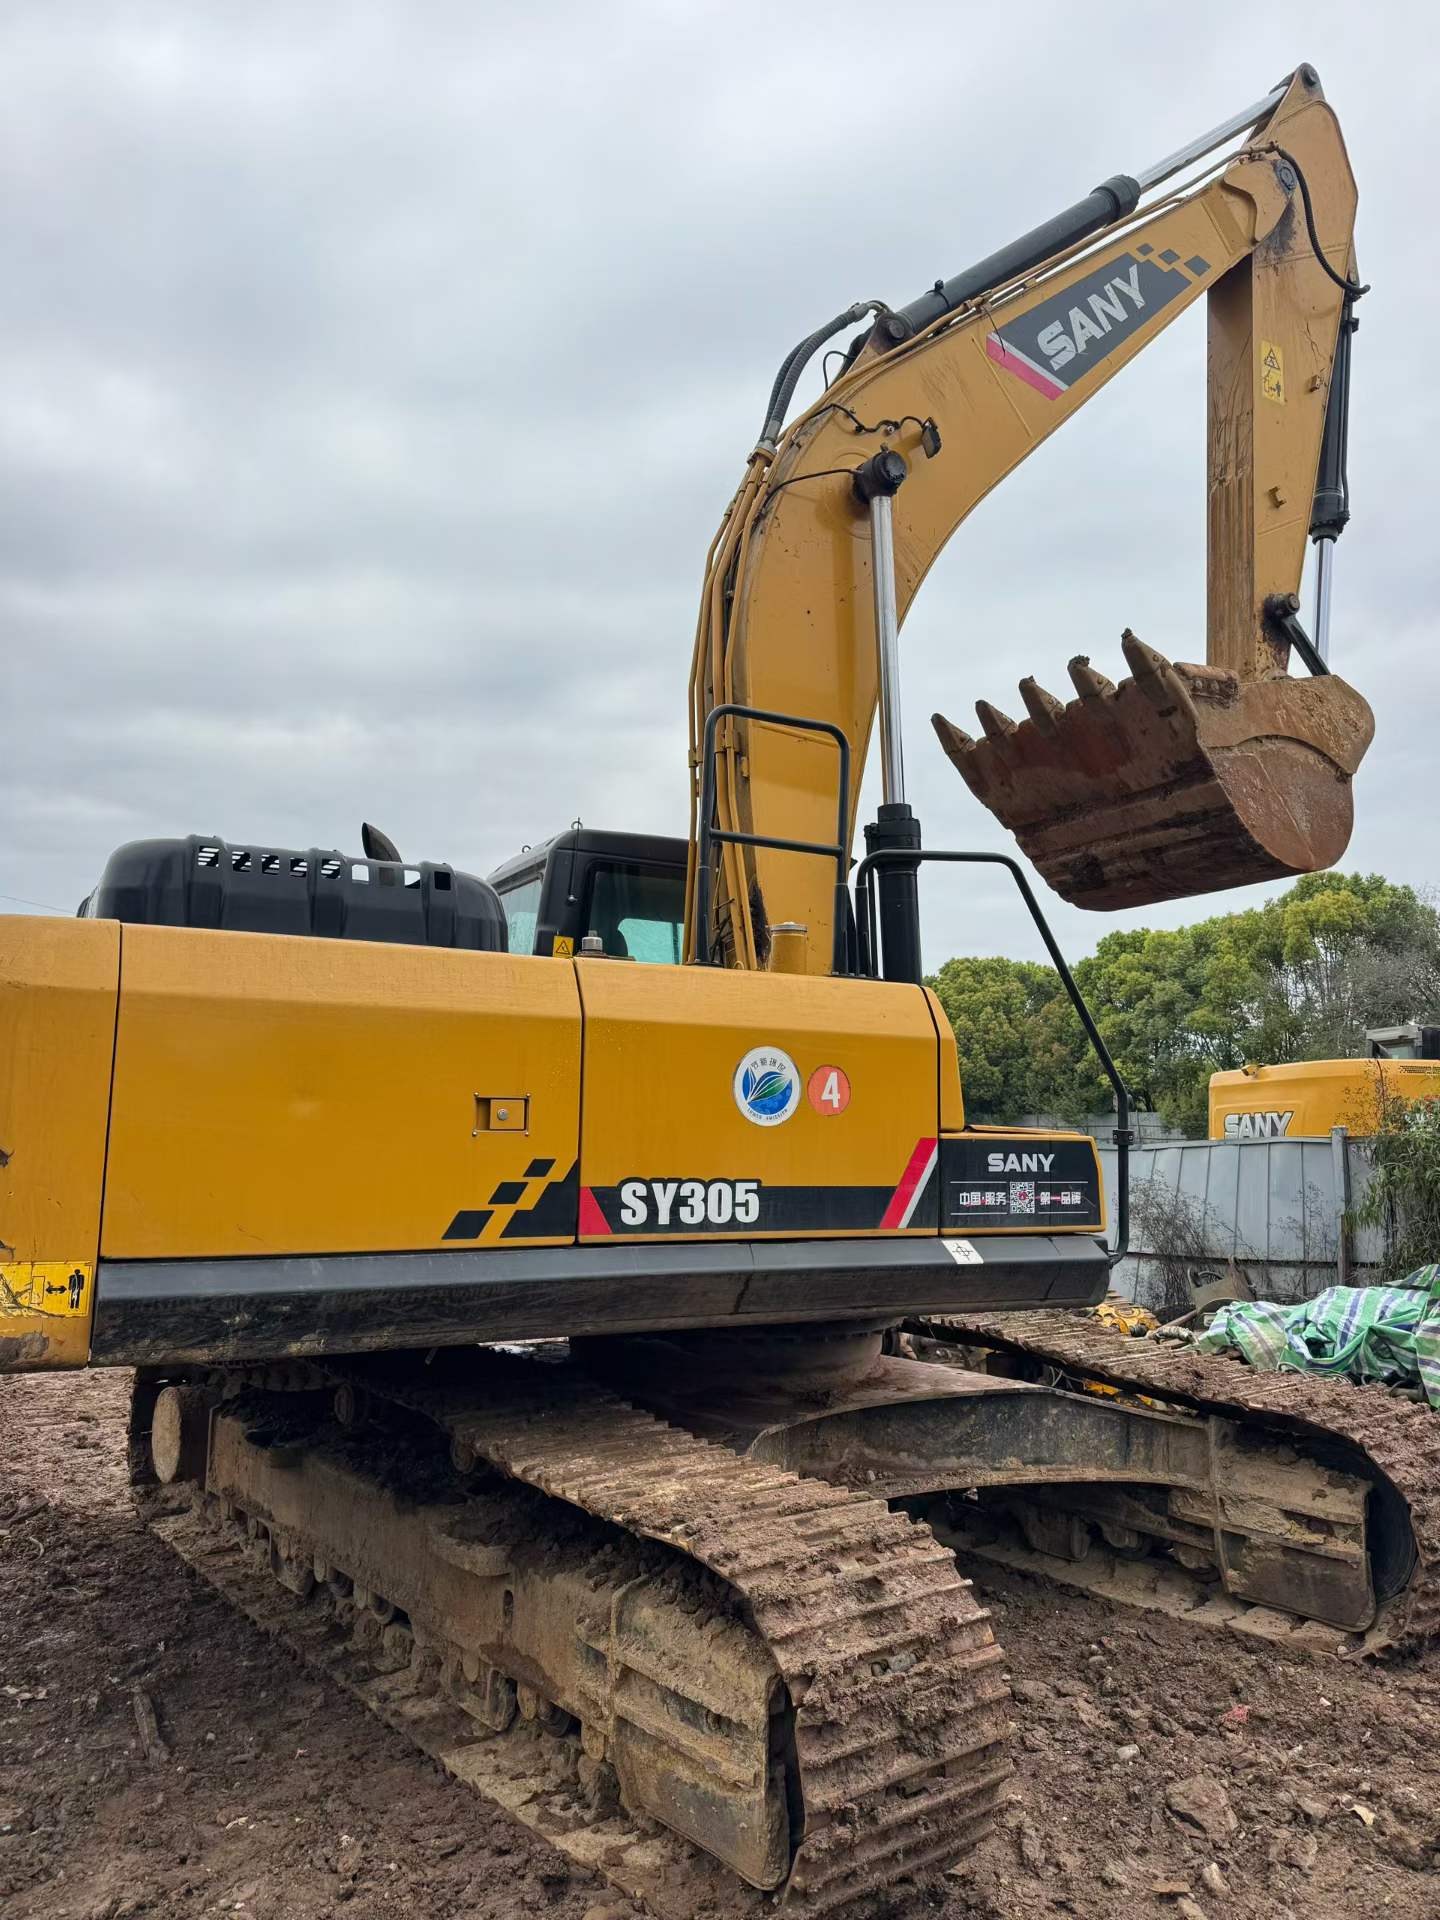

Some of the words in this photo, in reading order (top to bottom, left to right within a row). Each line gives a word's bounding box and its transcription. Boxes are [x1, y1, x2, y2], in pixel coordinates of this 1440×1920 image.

[1037, 263, 1146, 371] SANY
[821, 1071, 841, 1108] 4
[1224, 1110, 1294, 1139] SANY
[987, 1152, 1055, 1173] SANY
[620, 1181, 760, 1226] SY305
